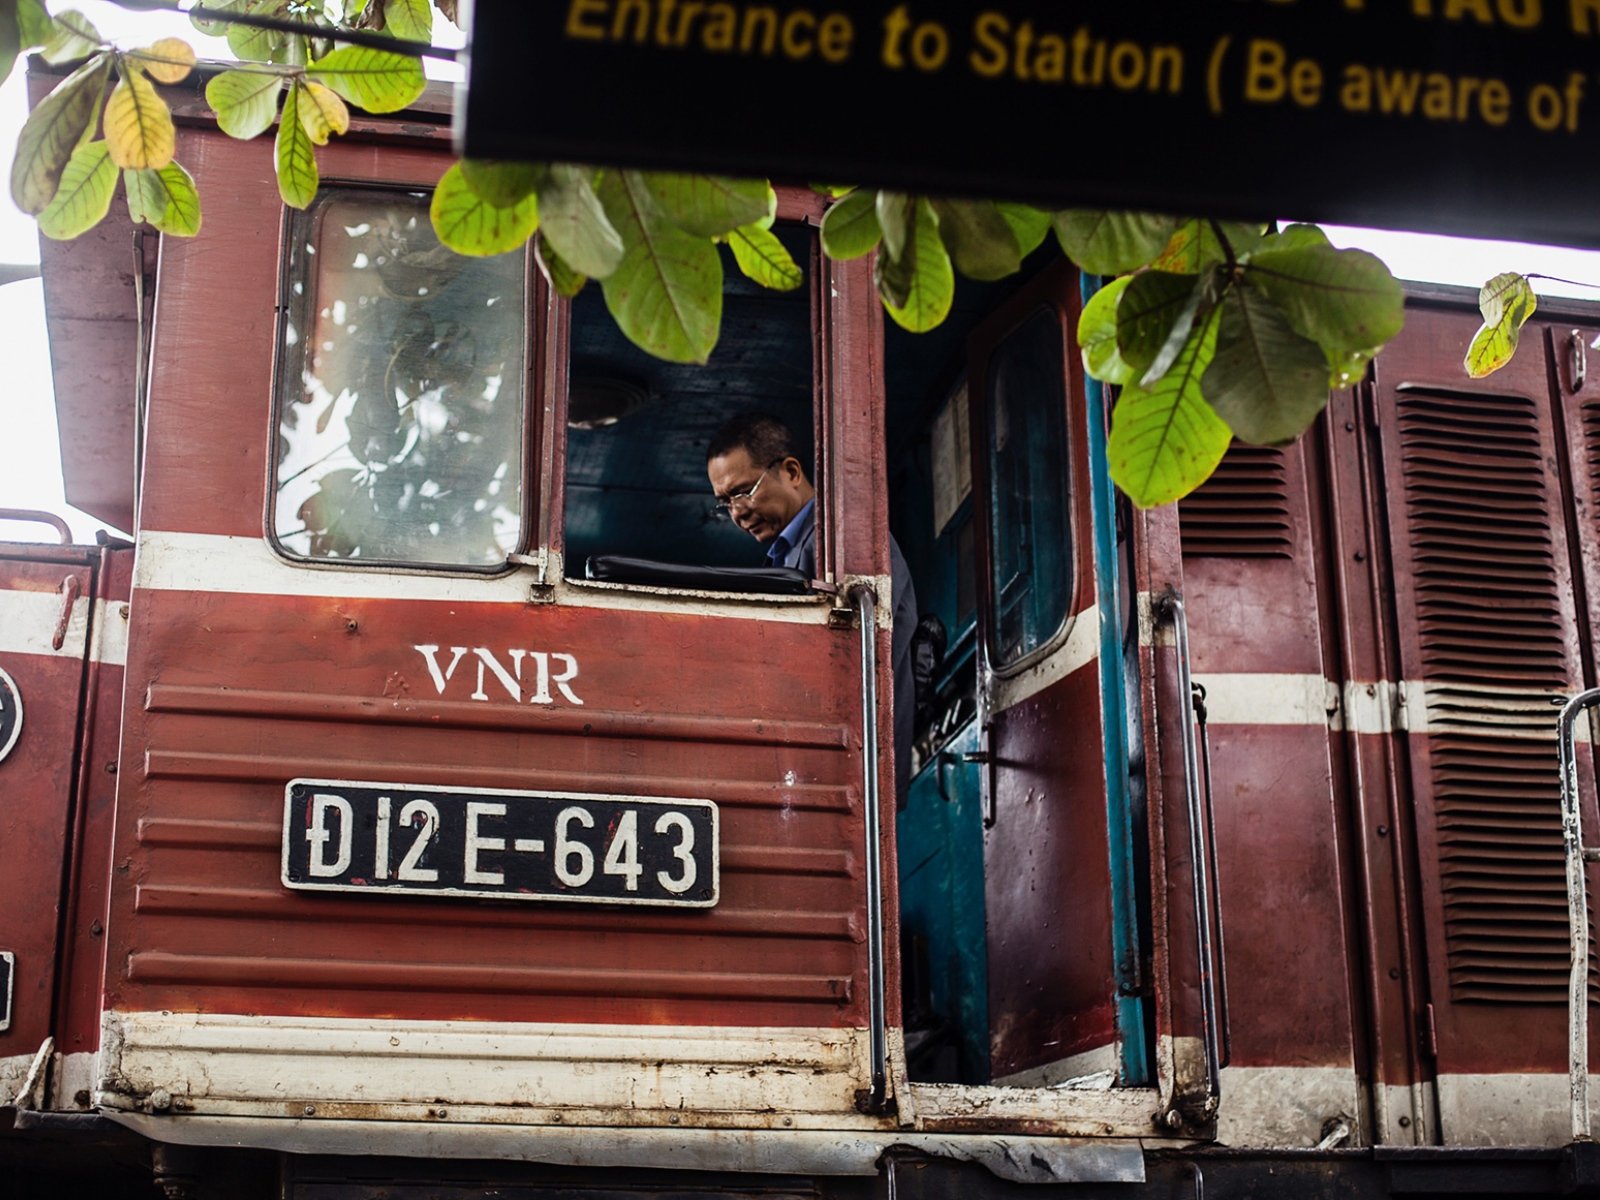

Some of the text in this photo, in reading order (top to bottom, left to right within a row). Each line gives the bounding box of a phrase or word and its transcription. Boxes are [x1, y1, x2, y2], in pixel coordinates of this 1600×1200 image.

[566, 0, 852, 61] Entrance
[883, 7, 948, 70] to
[970, 12, 1183, 92] Station
[1341, 65, 1510, 124] aware
[1529, 73, 1584, 132] of
[414, 643, 584, 705] VNR
